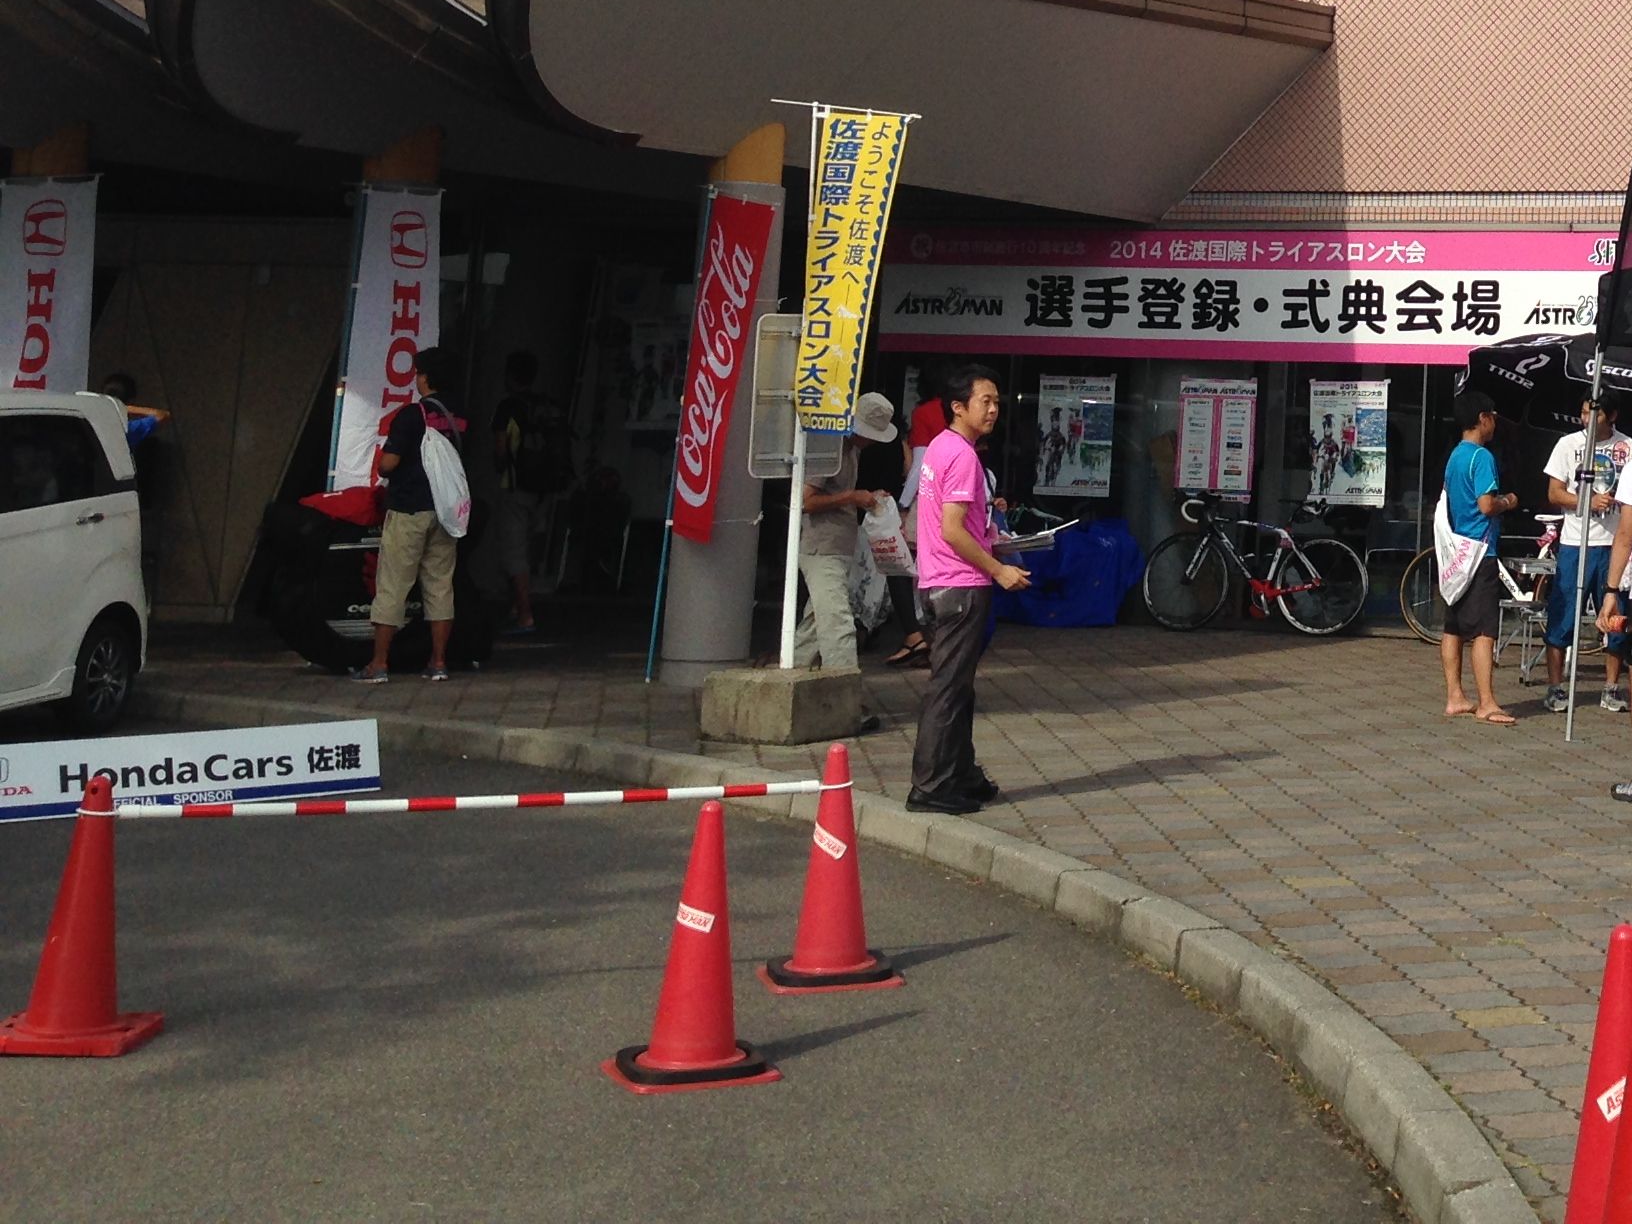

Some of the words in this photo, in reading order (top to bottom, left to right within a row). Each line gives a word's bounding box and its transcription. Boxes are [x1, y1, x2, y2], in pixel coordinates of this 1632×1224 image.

[841, 121, 892, 285] ようこそ佐渡へ
[798, 118, 868, 408] 佐渡国際トライアスロン大会
[1110, 240, 1162, 260] 2014
[1169, 240, 1427, 264] 佐渡国際トライアスロン大会
[13, 268, 56, 391] HO
[1024, 274, 1502, 337] 選手登録・式典会場
[307, 743, 362, 774] 佐渡
[173, 790, 234, 806] SPONSOR
